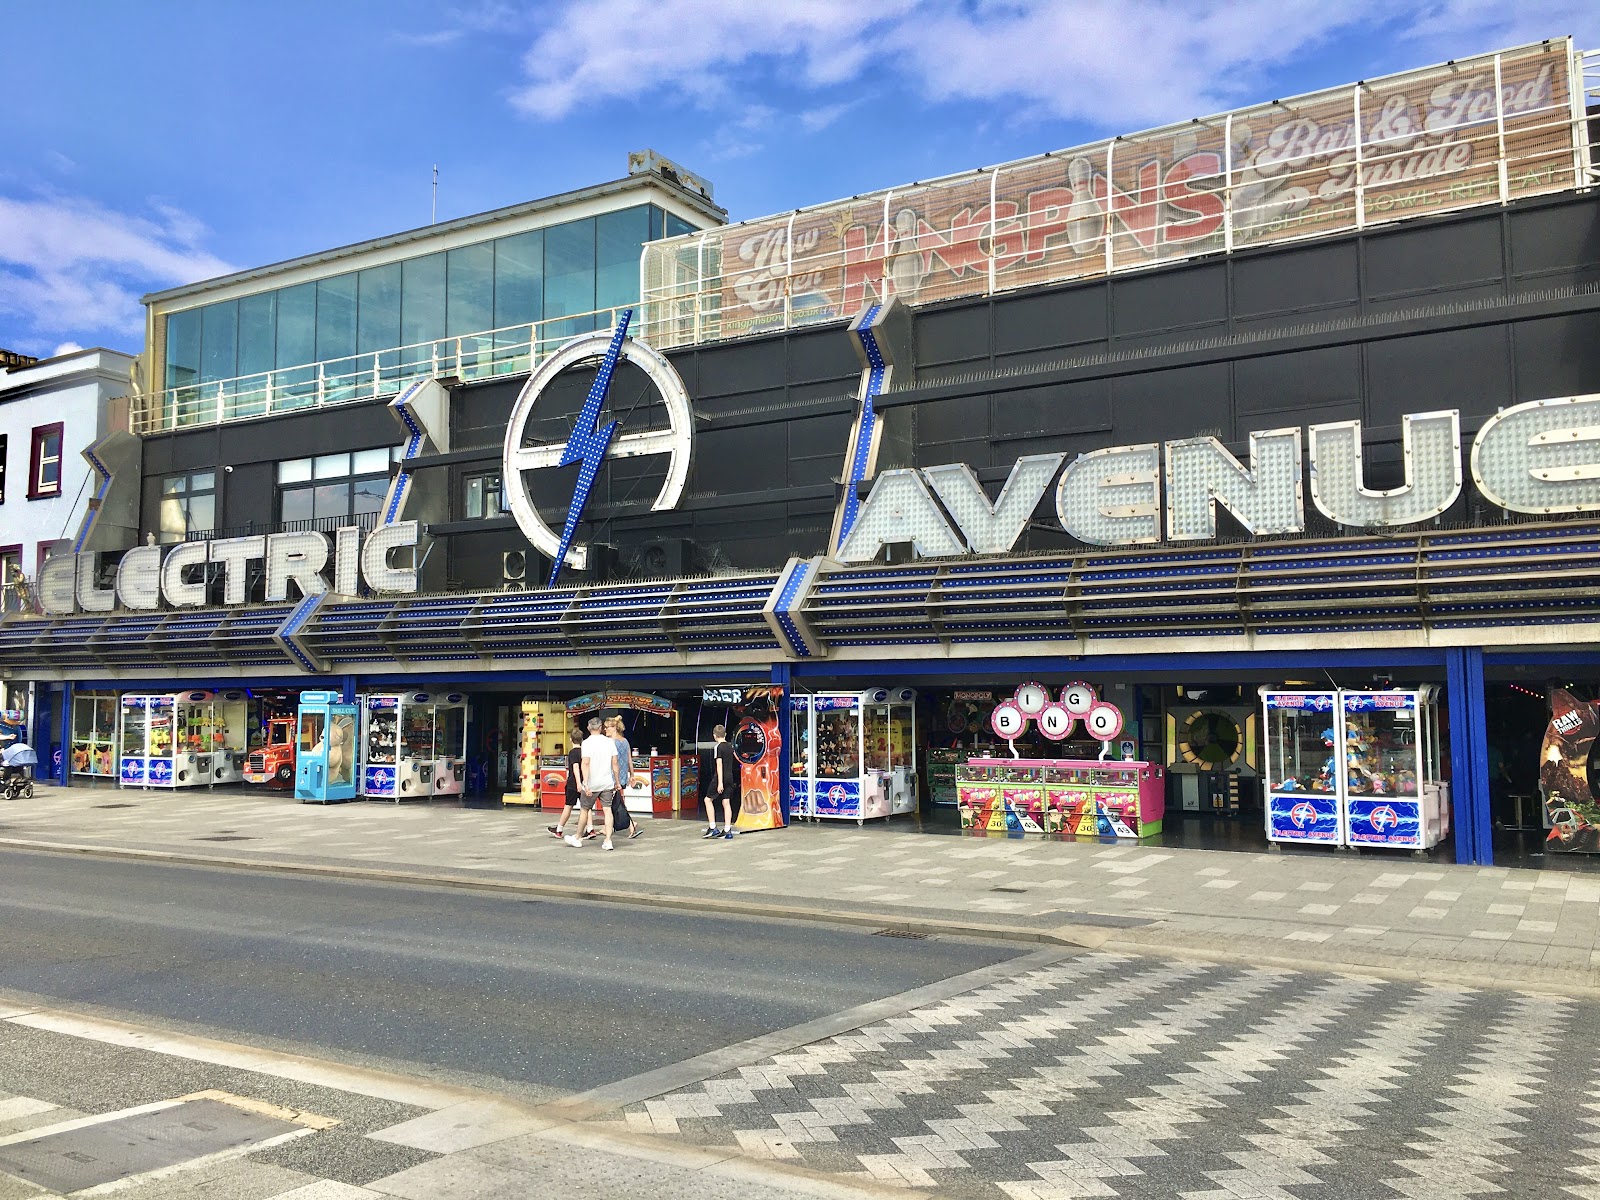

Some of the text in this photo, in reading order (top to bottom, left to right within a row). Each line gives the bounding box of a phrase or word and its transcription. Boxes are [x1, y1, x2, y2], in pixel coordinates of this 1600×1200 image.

[1253, 63, 1555, 174] Bar & Food
[1318, 133, 1474, 200] Inside
[831, 393, 1600, 562] AVENUE
[36, 520, 419, 616] ELECTRIC
[955, 690, 992, 699] MONOPOLY
[1552, 709, 1579, 730] RAW
[1273, 829, 1336, 839] ELECTRIC AVENUE
[1352, 833, 1418, 843] ELECTRIC AVENUE
